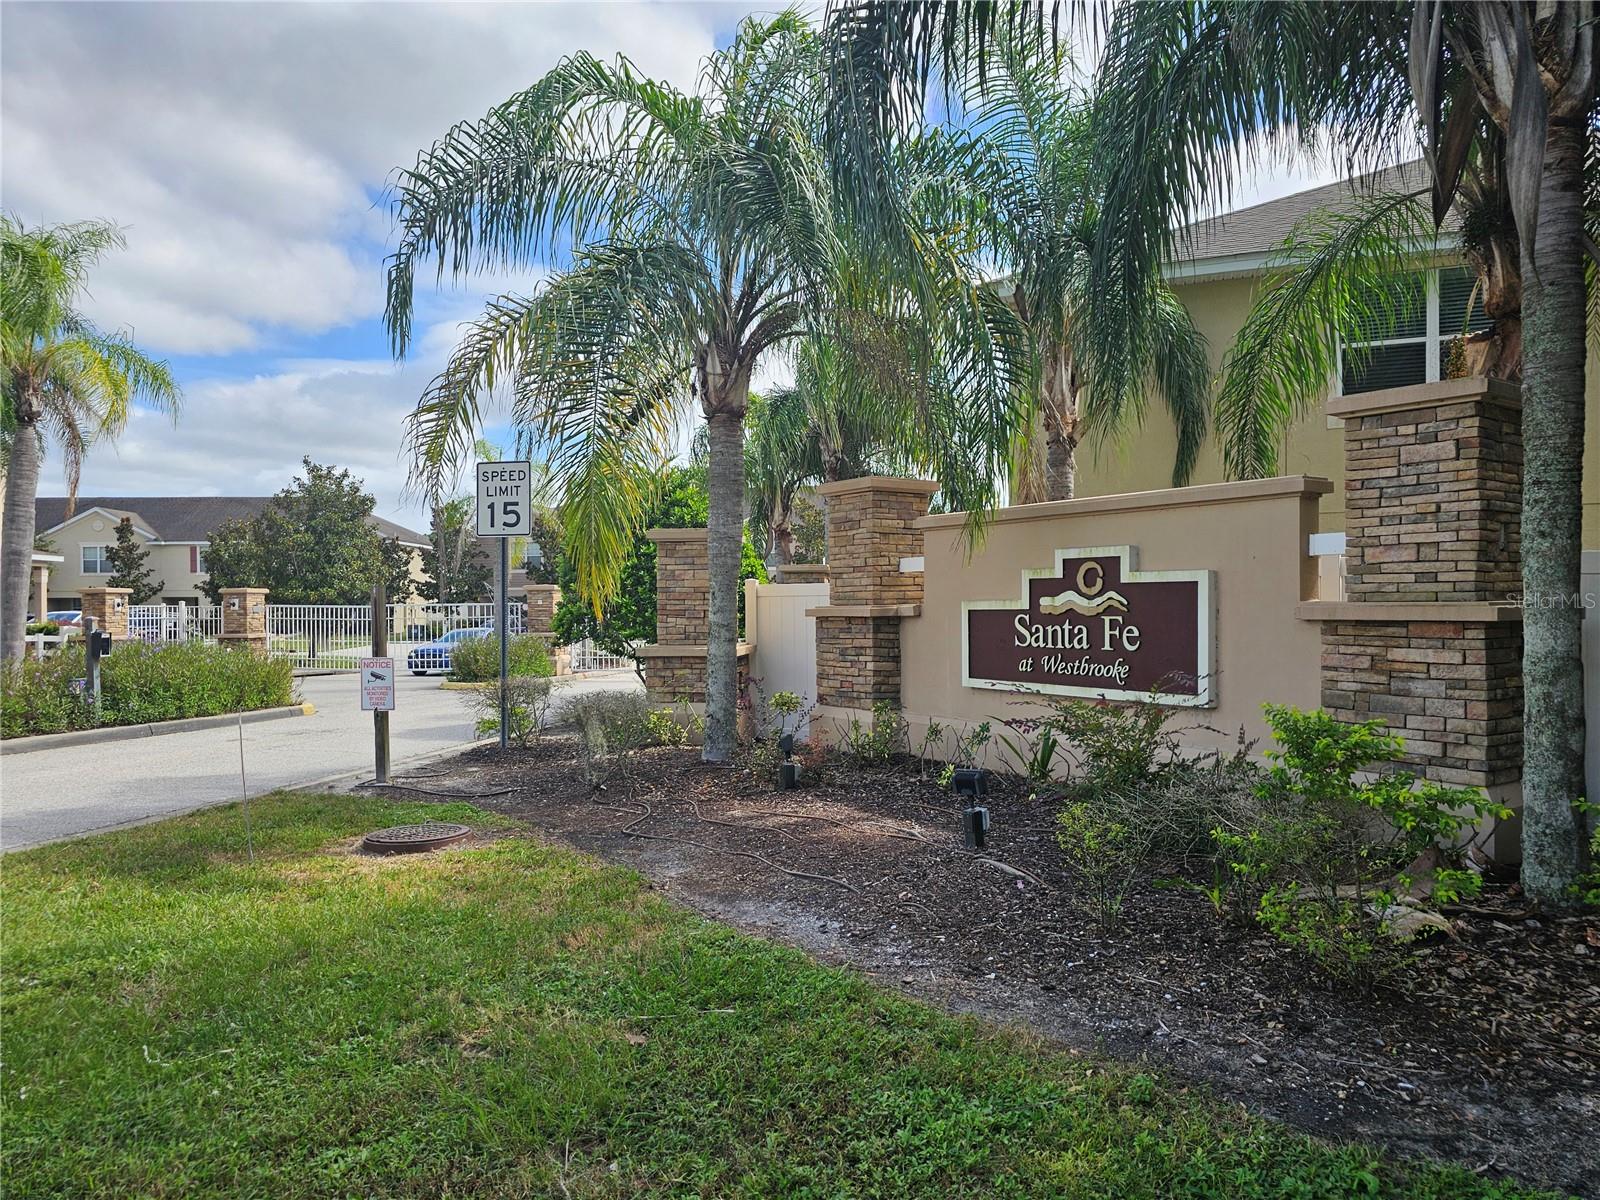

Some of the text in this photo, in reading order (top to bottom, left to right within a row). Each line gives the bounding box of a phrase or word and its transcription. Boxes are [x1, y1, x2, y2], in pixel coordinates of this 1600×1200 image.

[481, 470, 526, 482] SPEED
[486, 485, 521, 497] LIMIT
[487, 501, 521, 528] 15
[1014, 614, 1140, 652] Santa Fe
[363, 661, 391, 669] NOTICE
[1018, 653, 1130, 685] at Westbrooke
